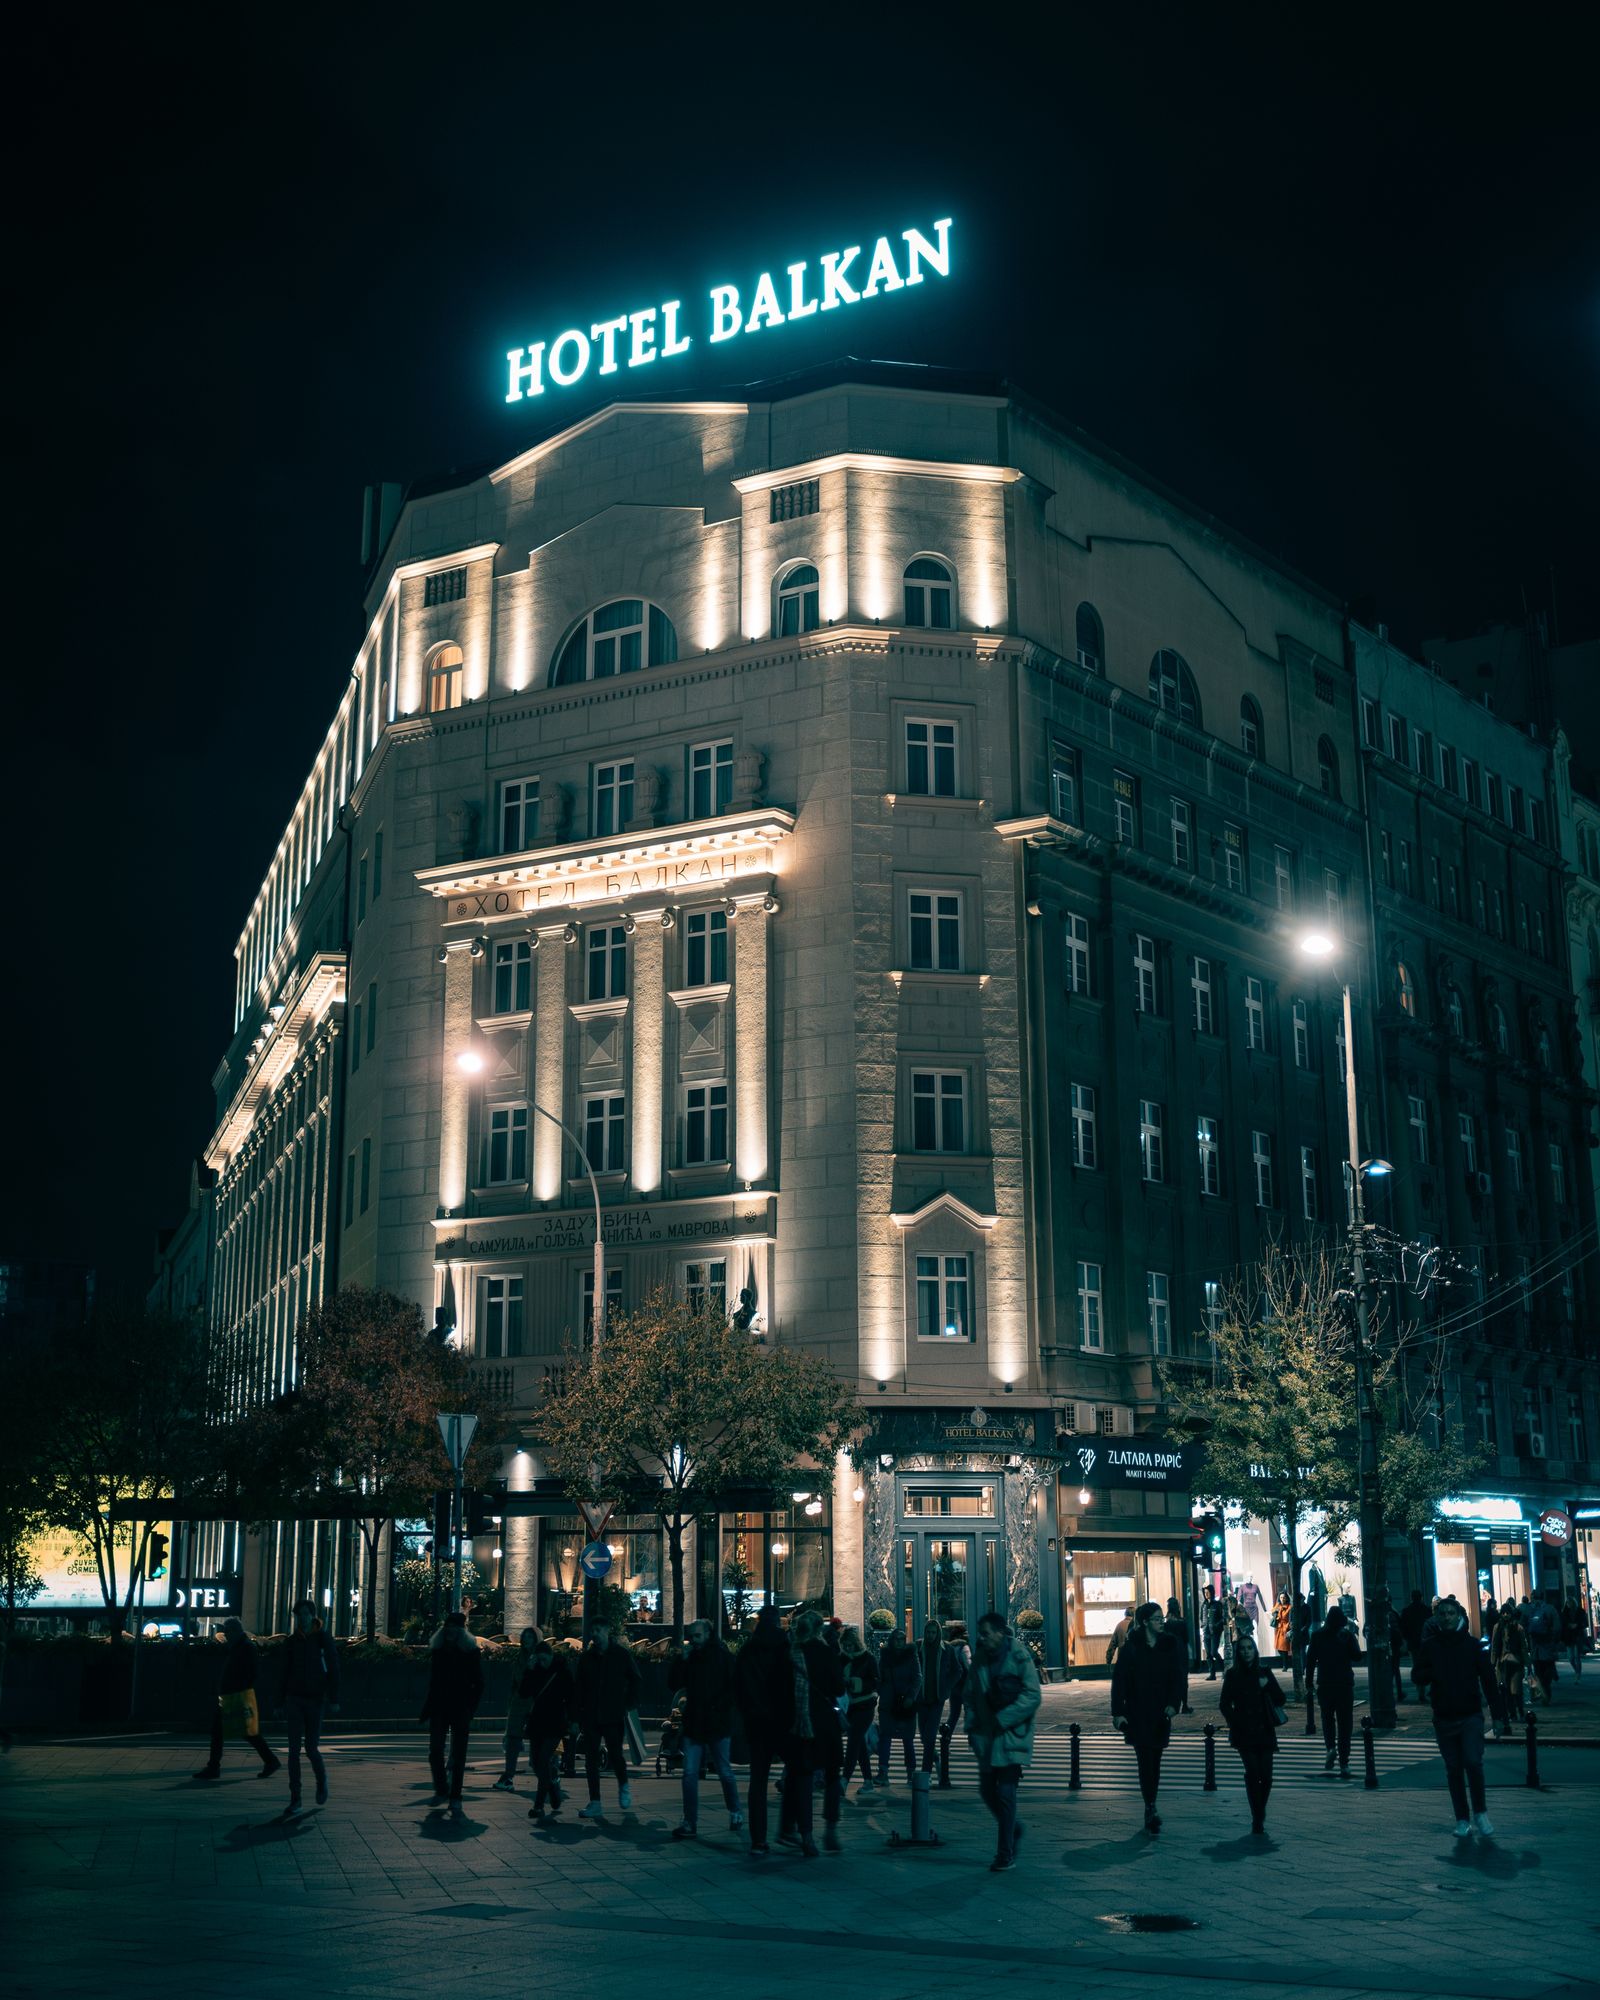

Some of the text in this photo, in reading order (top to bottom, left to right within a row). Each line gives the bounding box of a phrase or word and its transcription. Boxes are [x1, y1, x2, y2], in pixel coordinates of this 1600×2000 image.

[505, 217, 953, 403] HOTEL BALKAN
[474, 854, 738, 917] ХОТЕЛ БАЛКАН
[470, 1237, 525, 1254] САМУИЛА
[535, 1231, 585, 1249] ГОЛУБА
[668, 1220, 729, 1239] МАВРОВА
[945, 1428, 1014, 1439] HOTEL BALKAN
[1107, 1450, 1183, 1469] ZLATARA PAPIĆ
[1125, 1469, 1142, 1478] NAKIT
[1147, 1470, 1167, 1480] SATOVI
